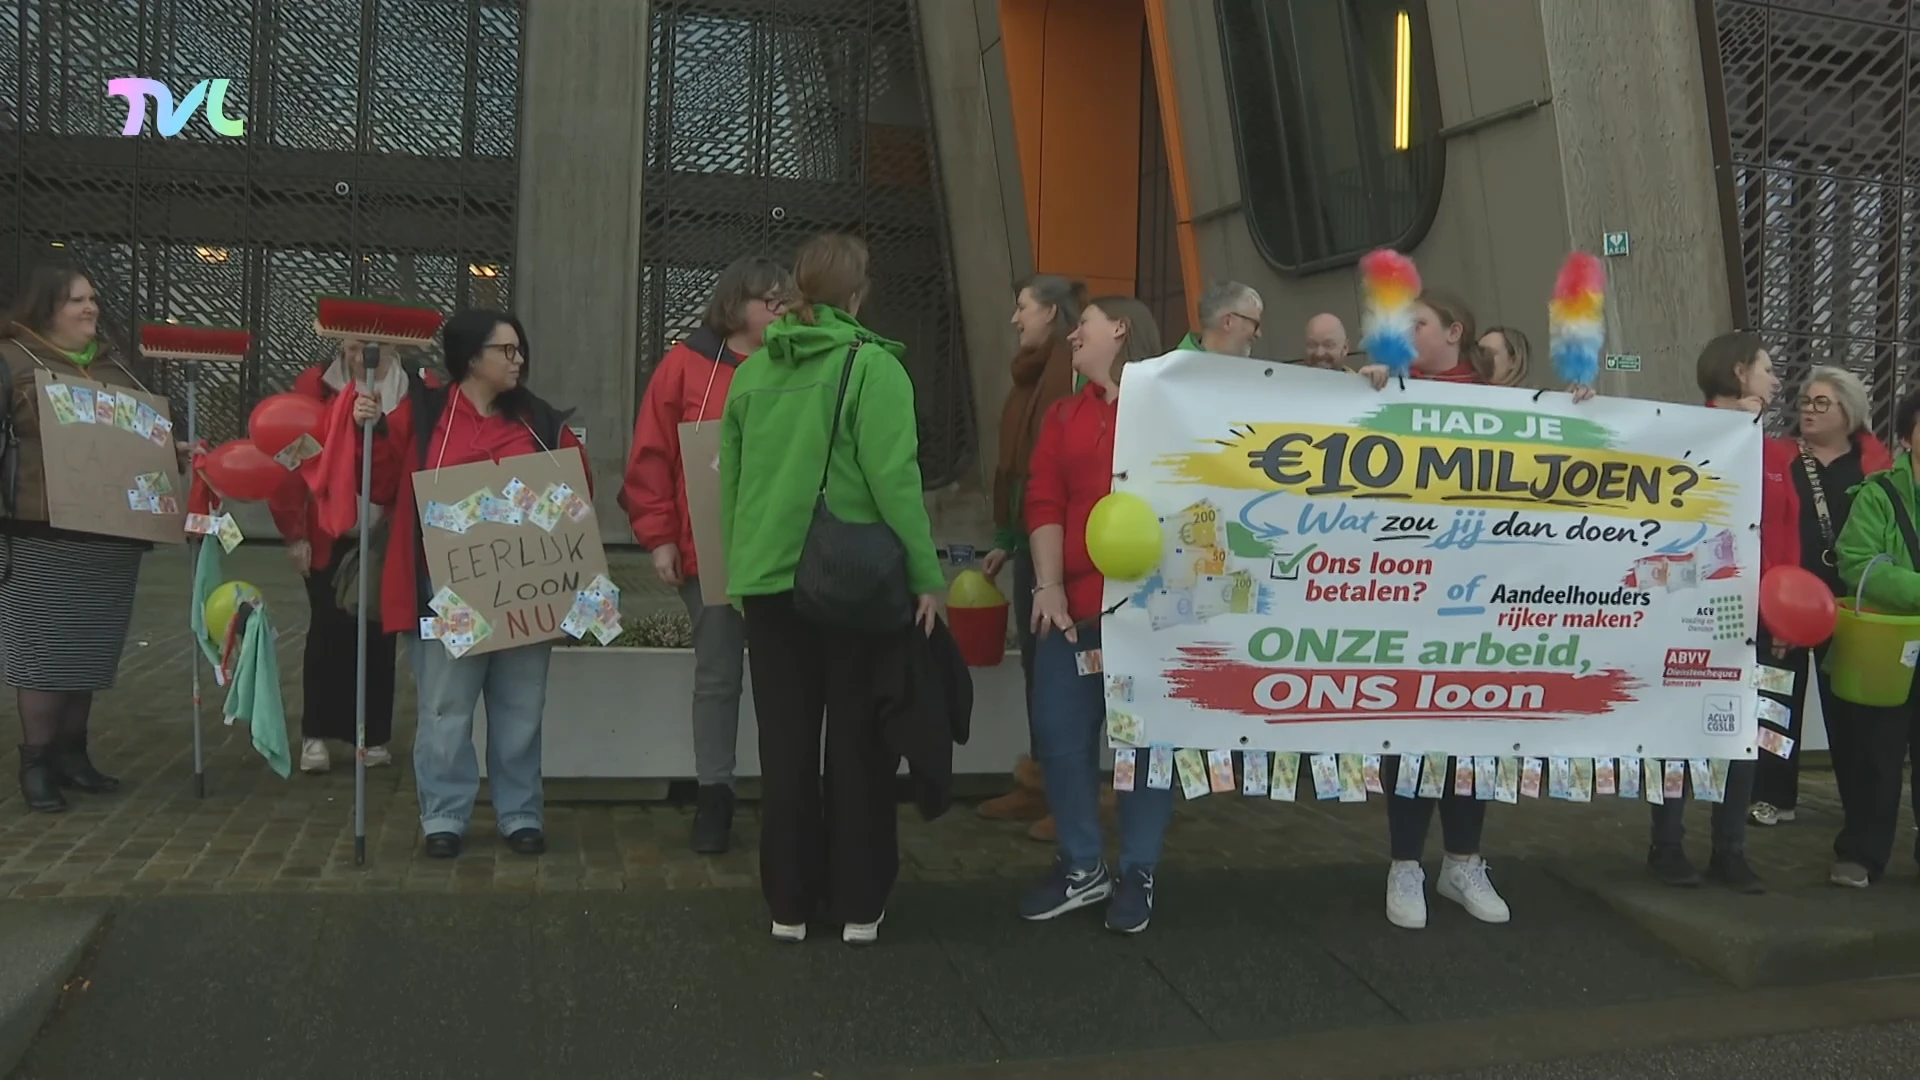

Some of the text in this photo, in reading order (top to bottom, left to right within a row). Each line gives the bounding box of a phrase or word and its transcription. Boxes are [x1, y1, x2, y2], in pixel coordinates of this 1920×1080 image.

[1412, 408, 1564, 441] HAD JE
[1248, 432, 1699, 508] €10 MILJOEN?
[1193, 509, 1216, 524] 200
[1297, 502, 1661, 550] Wat zou jij dan doen?
[447, 532, 585, 585] EERLIJK
[1212, 551, 1226, 562] 50
[1306, 551, 1433, 576] Ons loon
[493, 571, 580, 608] LOON
[1235, 578, 1251, 589] 100
[1305, 579, 1428, 603] betalen?
[1446, 574, 1487, 603] of
[1489, 583, 1651, 606] Aandeelhouders
[506, 603, 557, 640] NU
[1497, 606, 1644, 632] rijker maken?
[1696, 607, 1715, 616] ACV
[1248, 626, 1592, 674] ONZE arbeid,
[1668, 651, 1707, 664] ABVV
[1666, 667, 1739, 678] Dienstencheques
[1252, 672, 1545, 710] ONS loon
[1707, 713, 1735, 722] ACLVB
[1707, 722, 1735, 732] CGSLB
